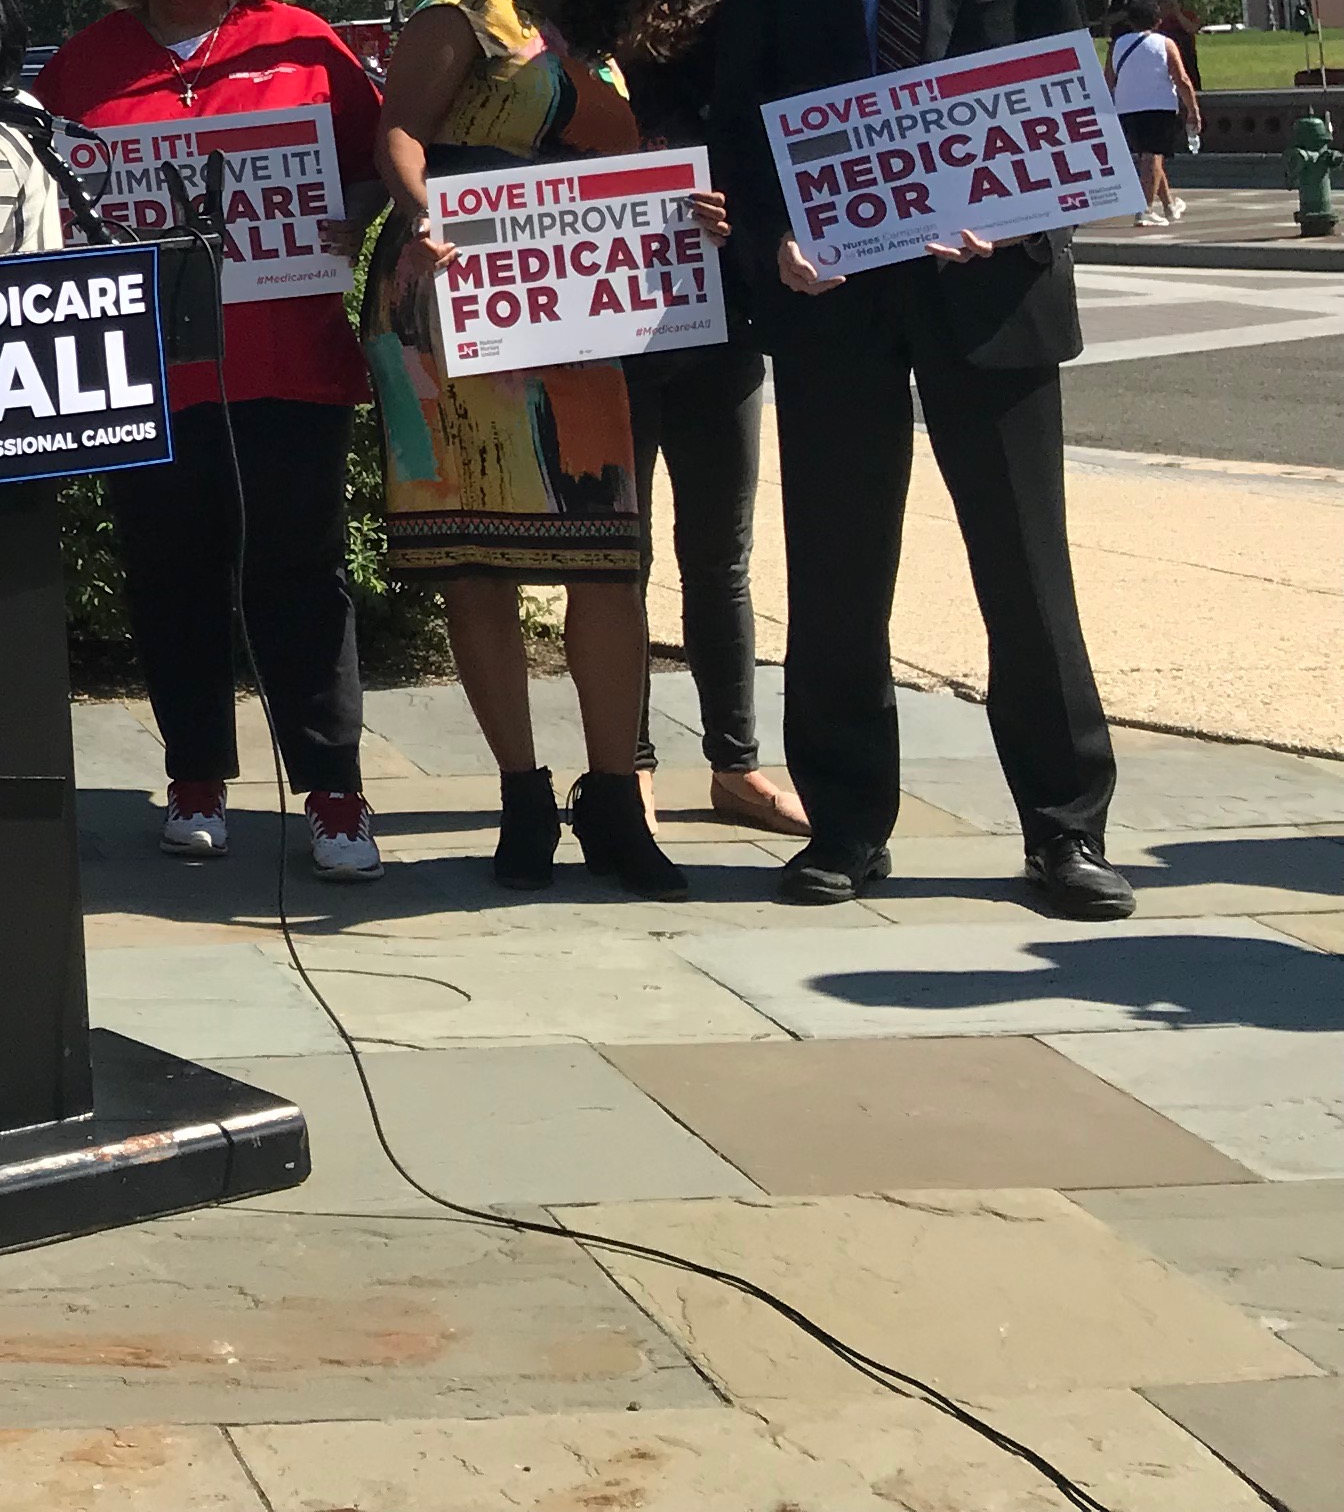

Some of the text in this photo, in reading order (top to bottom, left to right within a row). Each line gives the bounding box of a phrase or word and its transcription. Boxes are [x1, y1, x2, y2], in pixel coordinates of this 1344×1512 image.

[779, 77, 939, 137] LOVE IT!
[852, 76, 1091, 150] IMPROVE IT!
[70, 133, 195, 169] OVE IT!
[281, 150, 324, 178] IT!
[795, 106, 1104, 204] MEDICARE
[440, 177, 577, 219] LOVE IT!
[804, 142, 1116, 241] FOR ALL!
[501, 196, 689, 243] IMPROVE IT
[446, 228, 705, 292] MEDICARE
[842, 236, 880, 251] Nurses
[856, 243, 884, 257] Heal
[888, 232, 940, 250] America
[257, 269, 337, 285] #Medicare4All
[451, 267, 707, 334] FOR ALL!
[636, 319, 711, 337] #Medicare4All
[81, 421, 157, 448] CAUCUS
